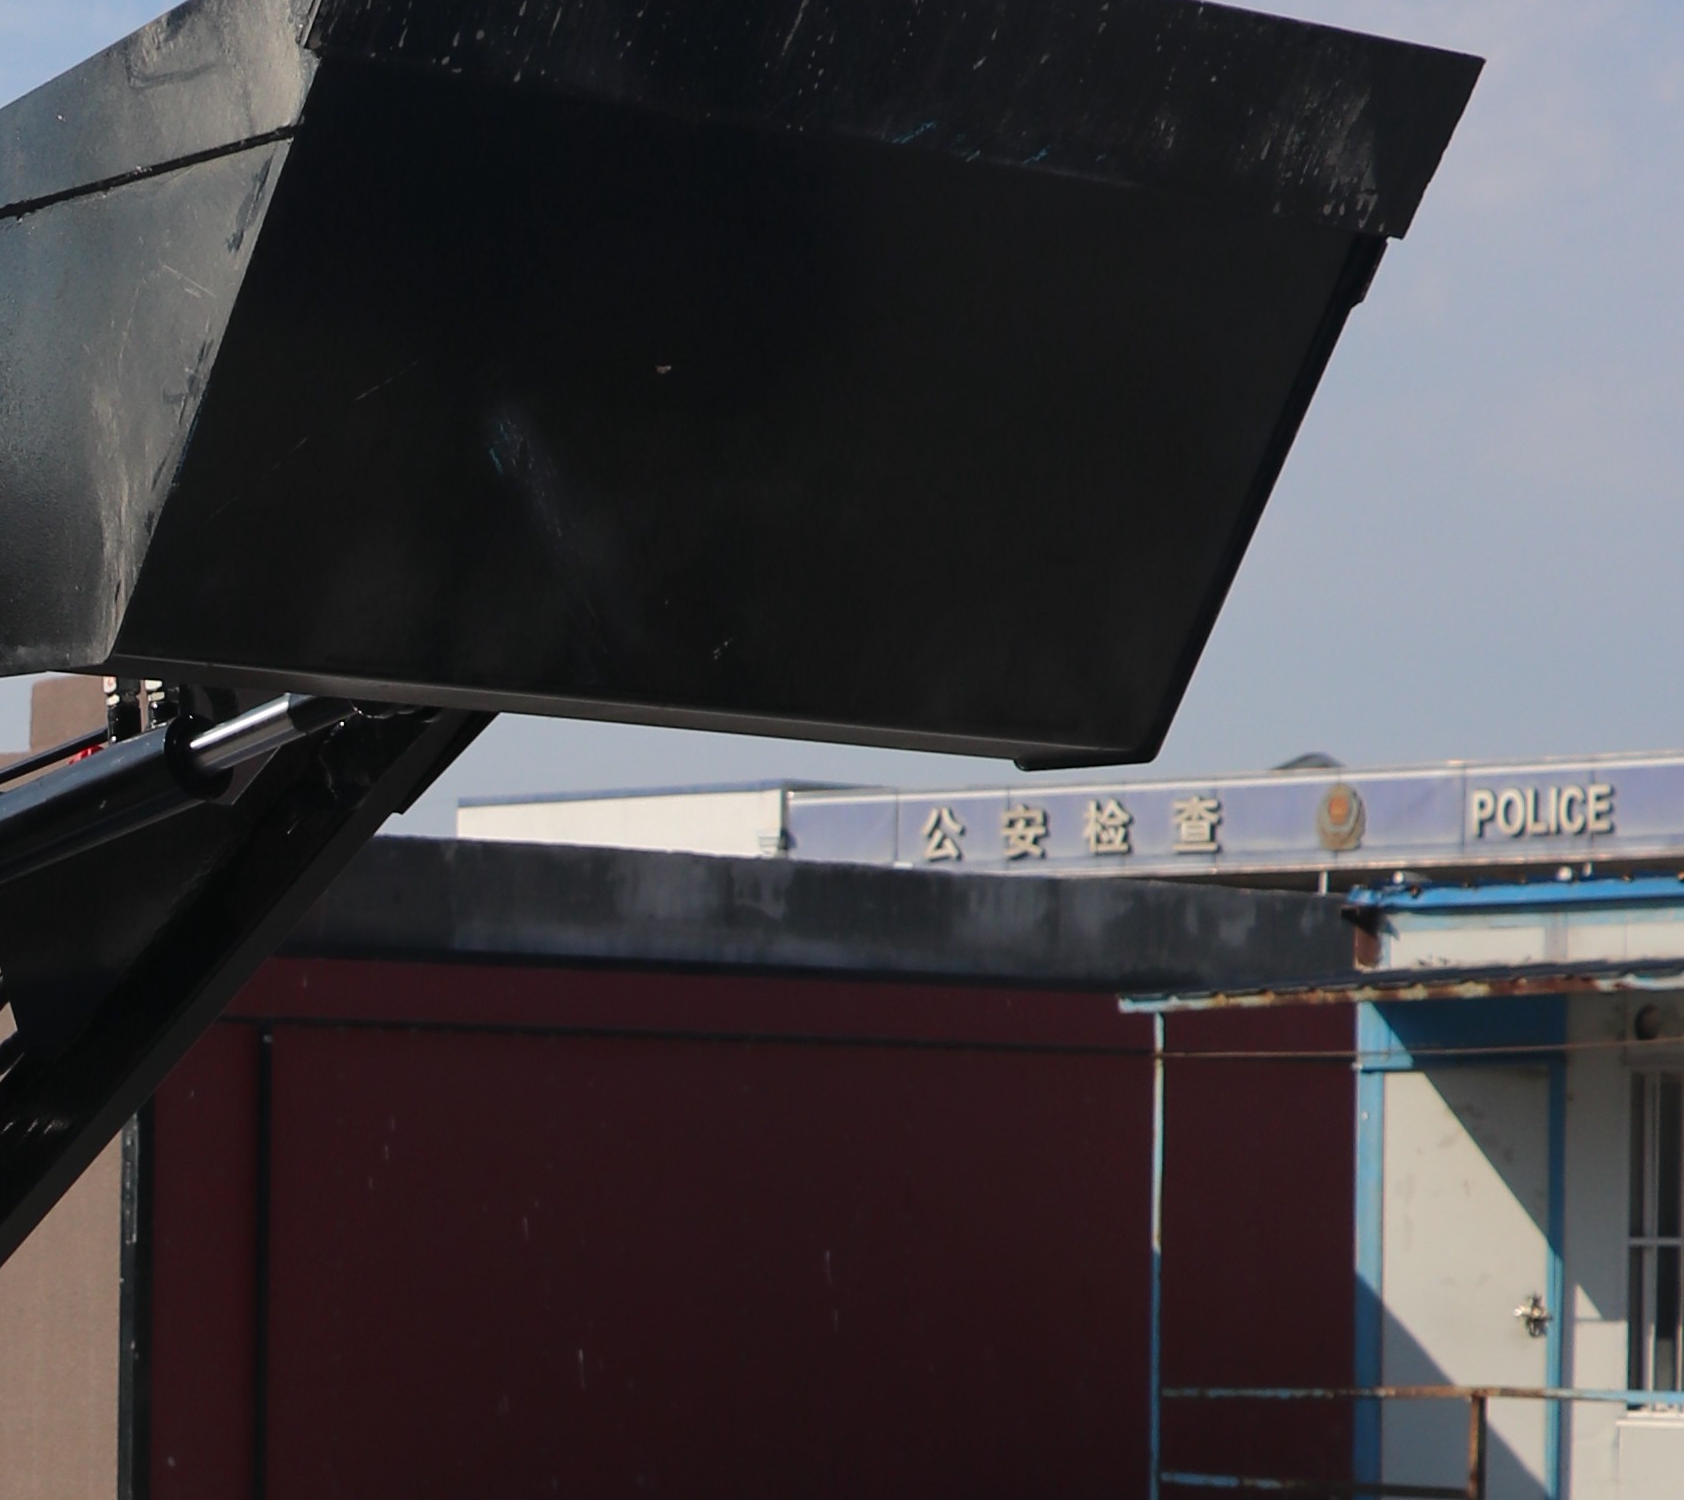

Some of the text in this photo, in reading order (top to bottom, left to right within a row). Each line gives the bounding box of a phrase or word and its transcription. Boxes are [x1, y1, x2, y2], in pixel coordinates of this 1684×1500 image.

[922, 797, 1222, 861] 公安检查
[1472, 784, 1614, 838] POLICE
